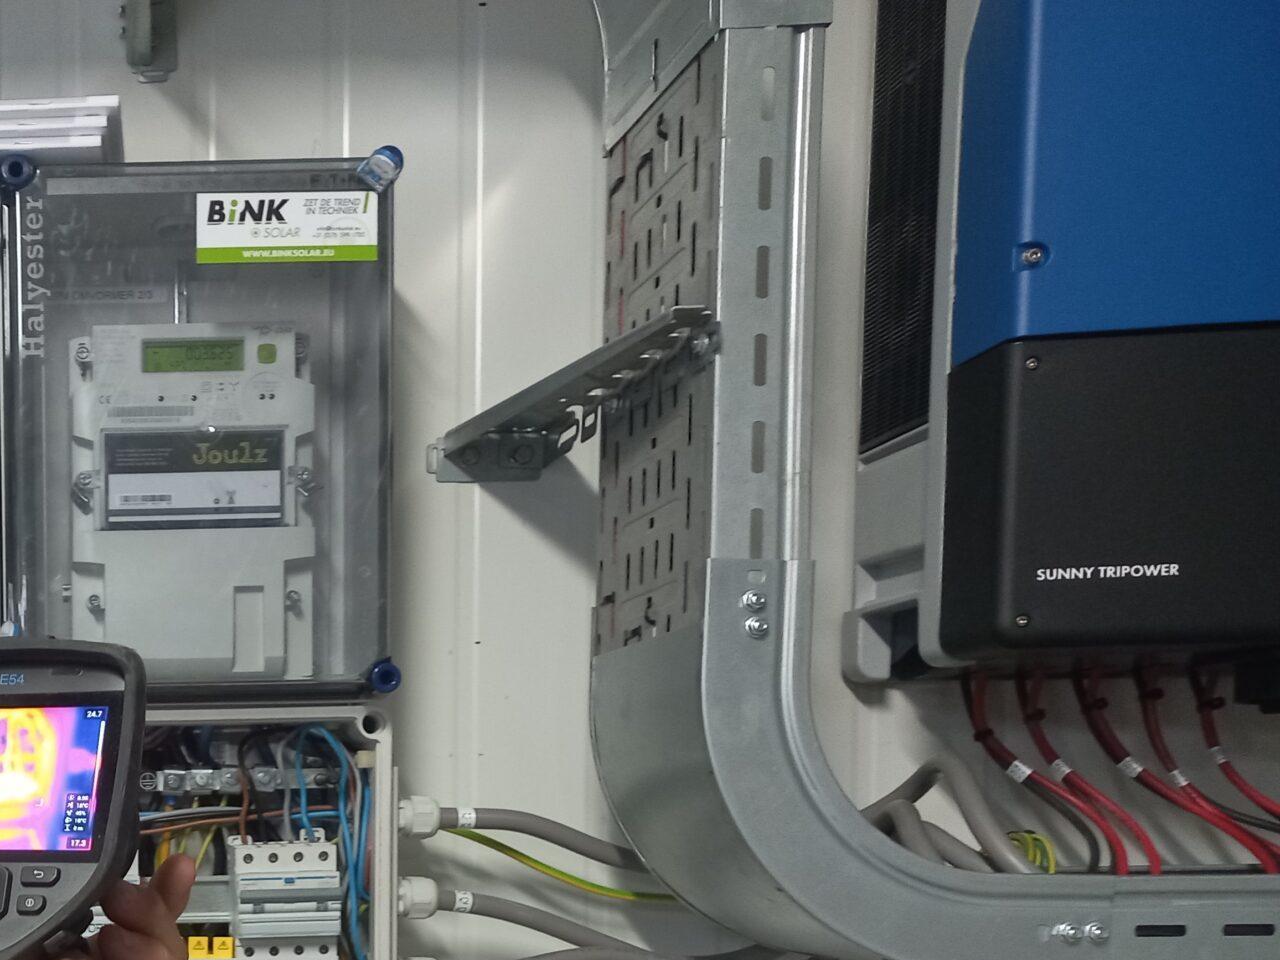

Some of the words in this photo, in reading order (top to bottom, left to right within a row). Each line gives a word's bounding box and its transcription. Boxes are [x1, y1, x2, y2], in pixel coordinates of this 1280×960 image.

[303, 198, 321, 208] ZET
[322, 198, 332, 207] DE
[333, 197, 362, 207] TREND
[306, 207, 317, 215] IN
[263, 227, 301, 239] SOLAR
[21, 195, 52, 360] Halyester
[192, 441, 269, 466] Joulz
[1036, 566, 1095, 581] SUNNY
[1098, 563, 1180, 579] TRIPOWER
[0, 673, 26, 686] E54
[86, 710, 102, 719] 24.7
